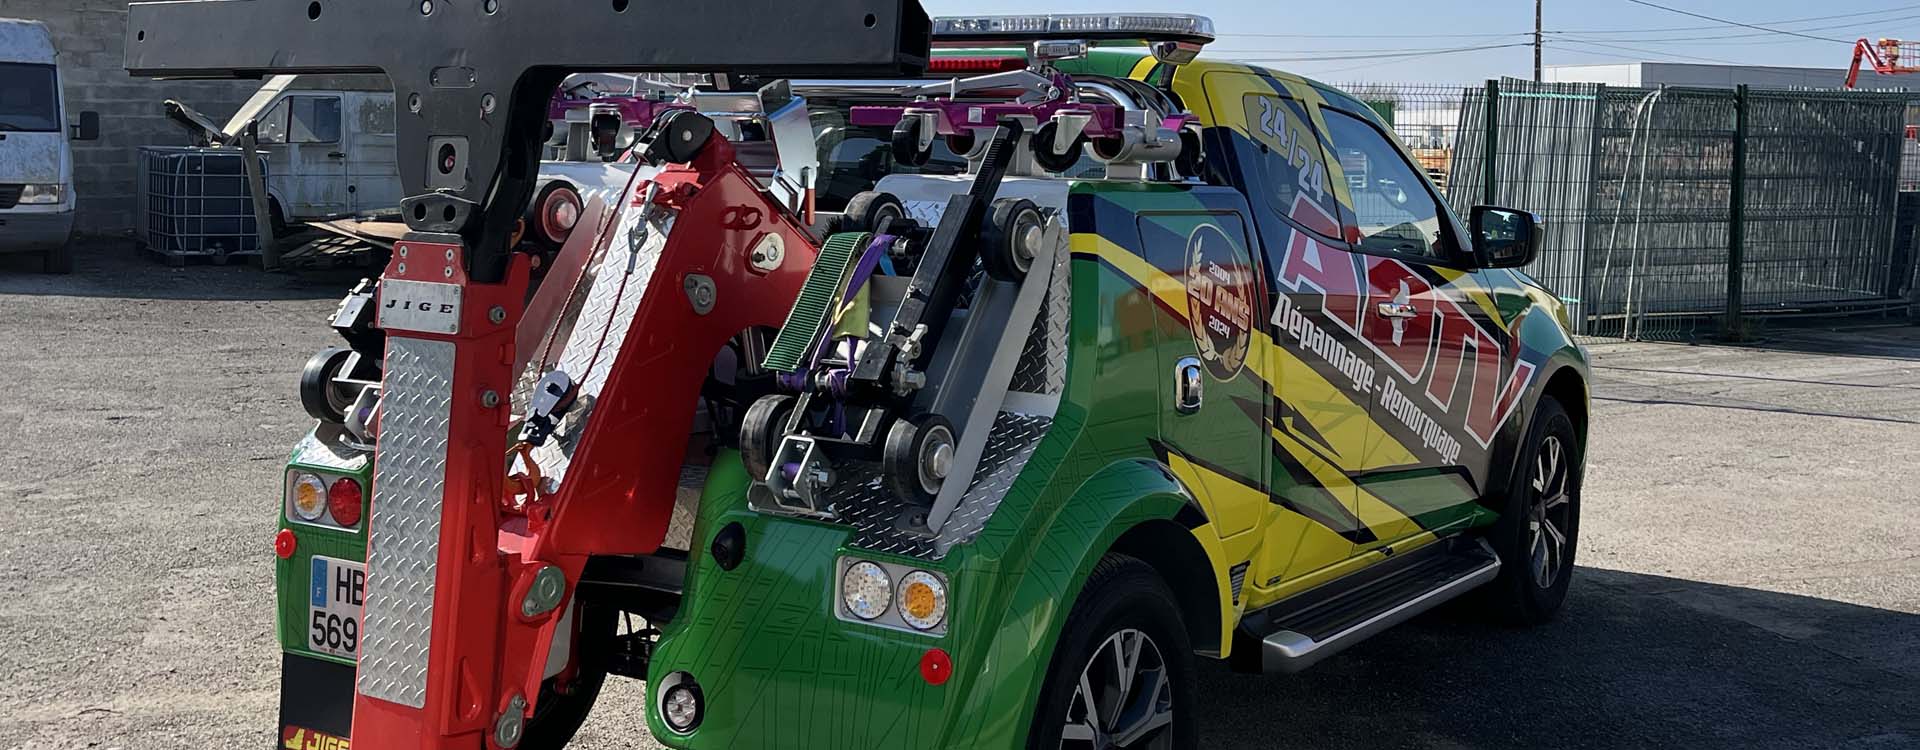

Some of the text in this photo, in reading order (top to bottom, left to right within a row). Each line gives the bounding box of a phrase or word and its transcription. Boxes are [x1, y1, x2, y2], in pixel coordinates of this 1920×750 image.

[1259, 95, 1324, 203] 24/24
[1208, 260, 1231, 285] 2004
[385, 299, 454, 314] JIGE
[1188, 269, 1250, 332] 20 ANS
[1208, 314, 1231, 339] 2024
[1270, 291, 1375, 394] Dépannage
[1379, 374, 1462, 465] Remorquage
[336, 566, 365, 607] HB
[311, 610, 358, 653] 569
